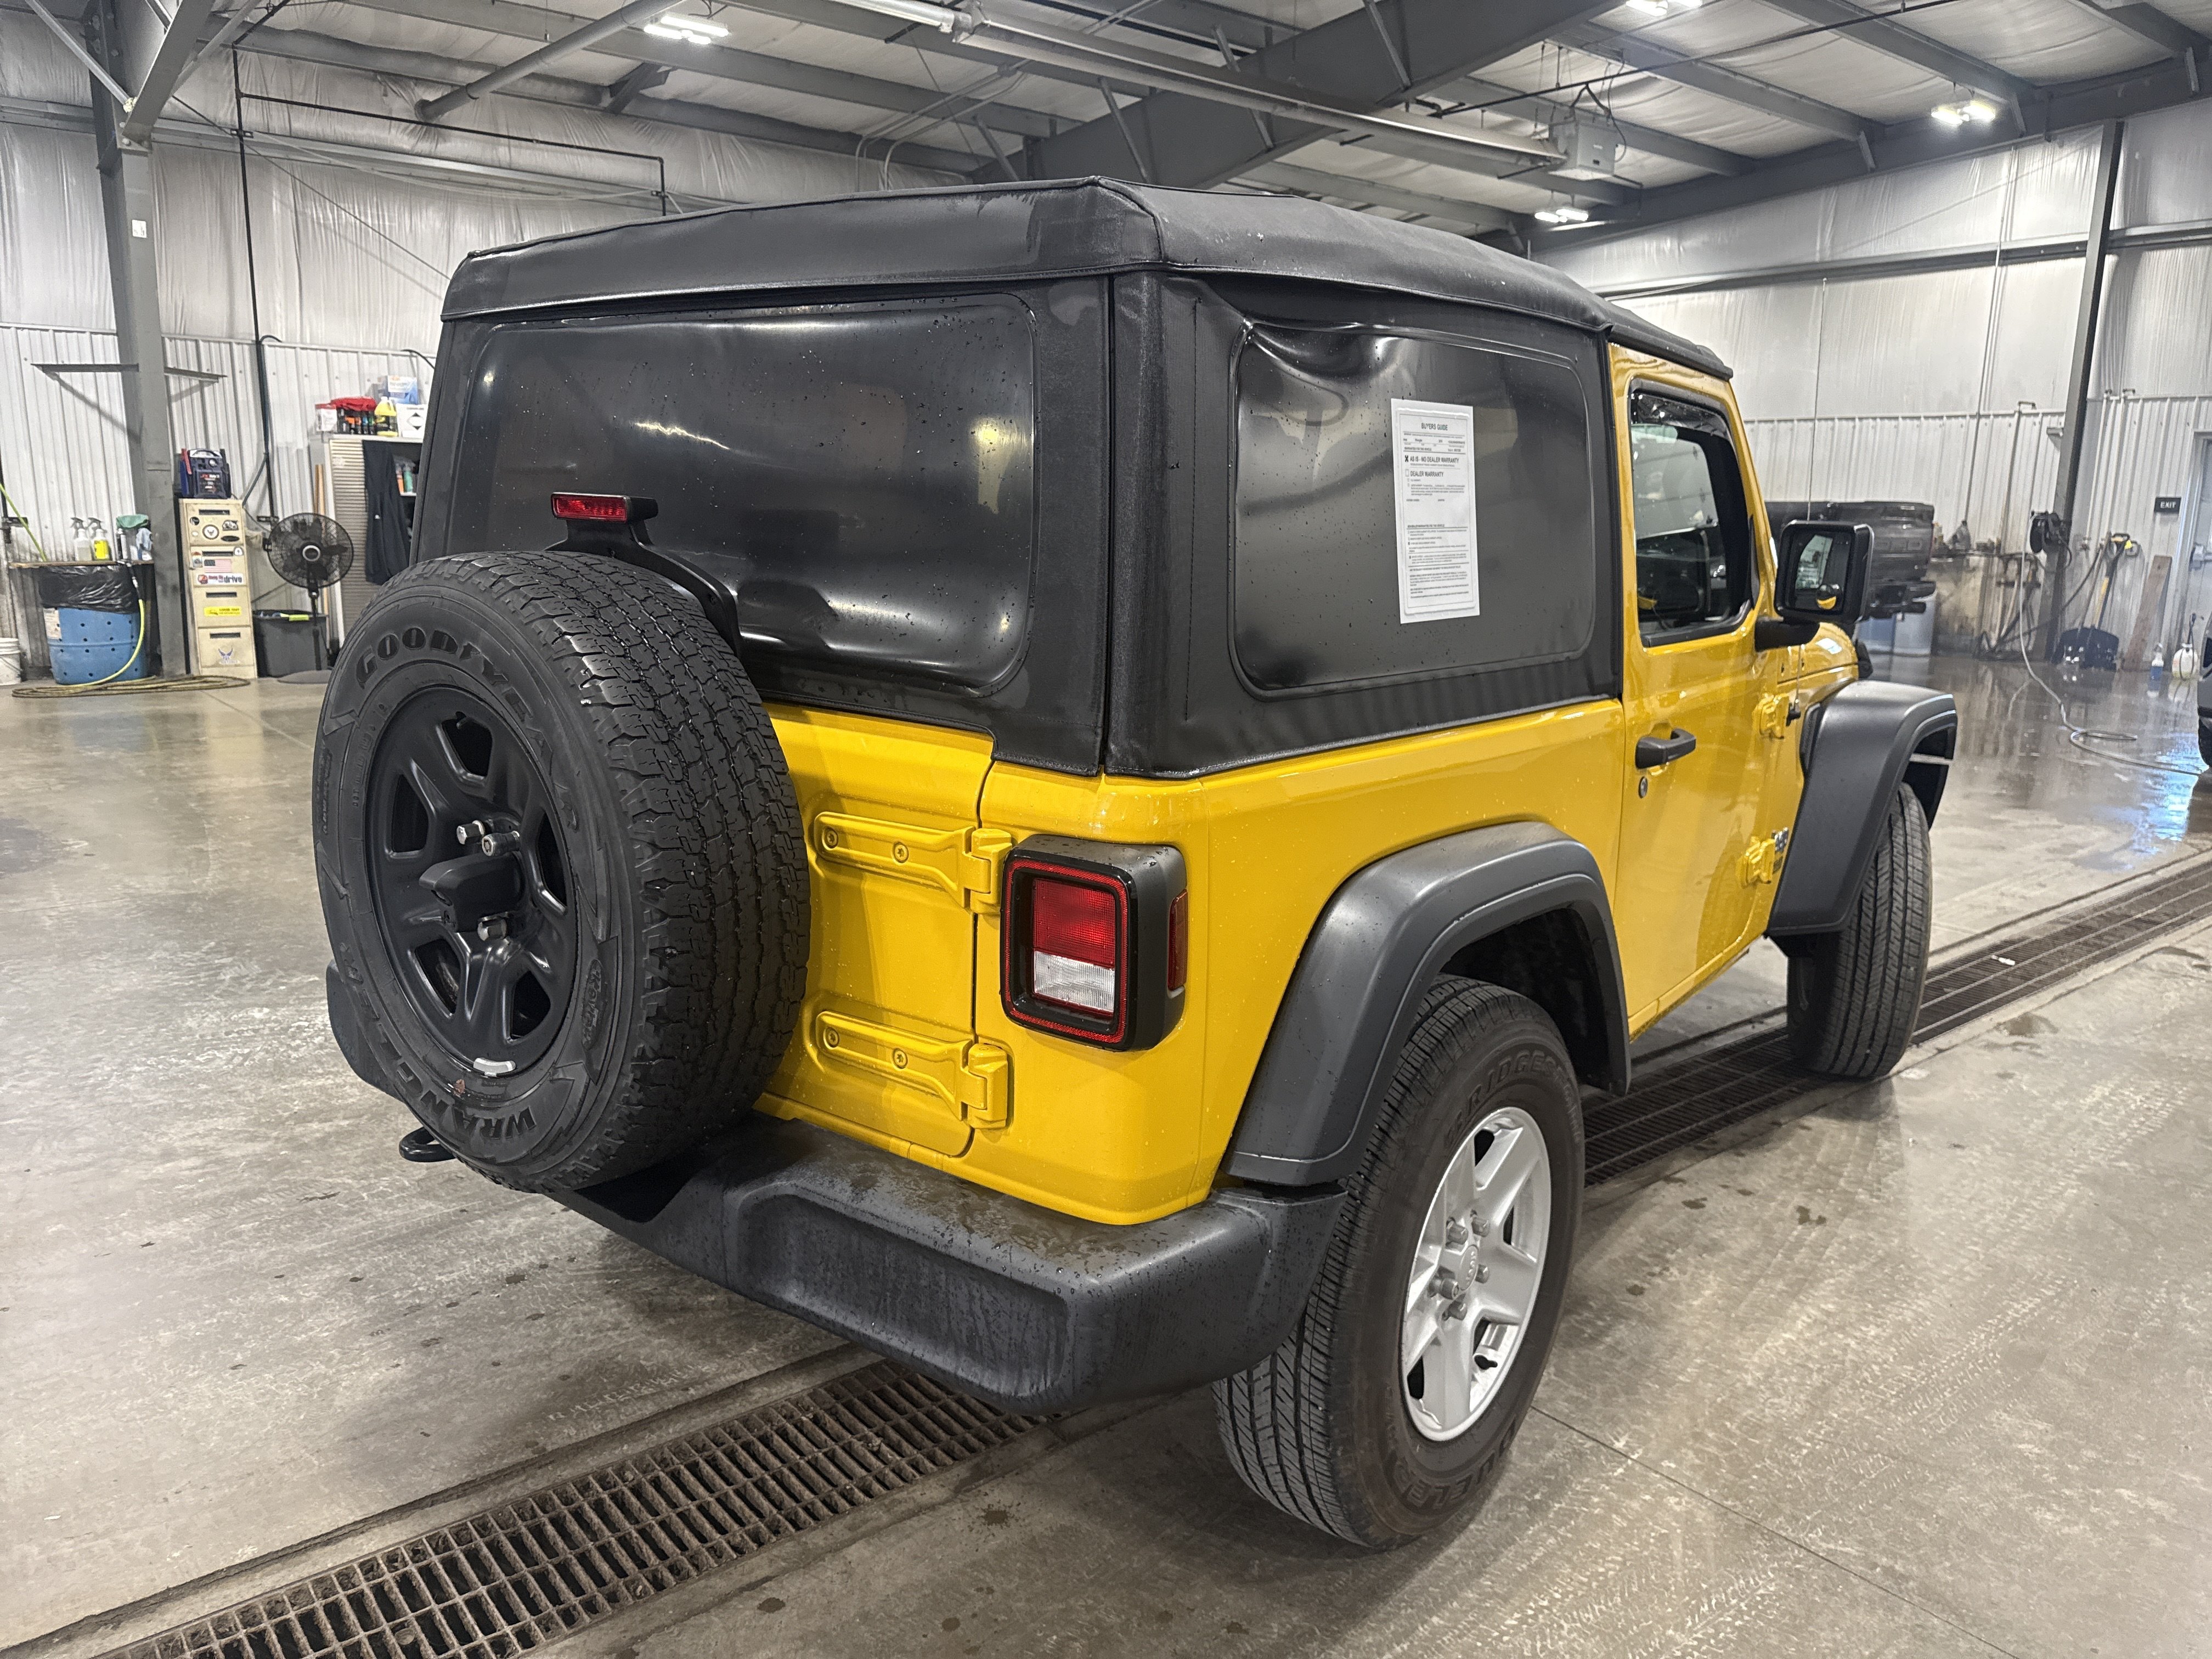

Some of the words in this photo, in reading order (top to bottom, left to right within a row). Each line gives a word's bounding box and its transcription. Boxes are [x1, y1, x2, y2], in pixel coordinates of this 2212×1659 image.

[224, 574, 242, 583] drive
[355, 626, 579, 832] GOODYEAR
[339, 942, 537, 1139] WRANGLER
